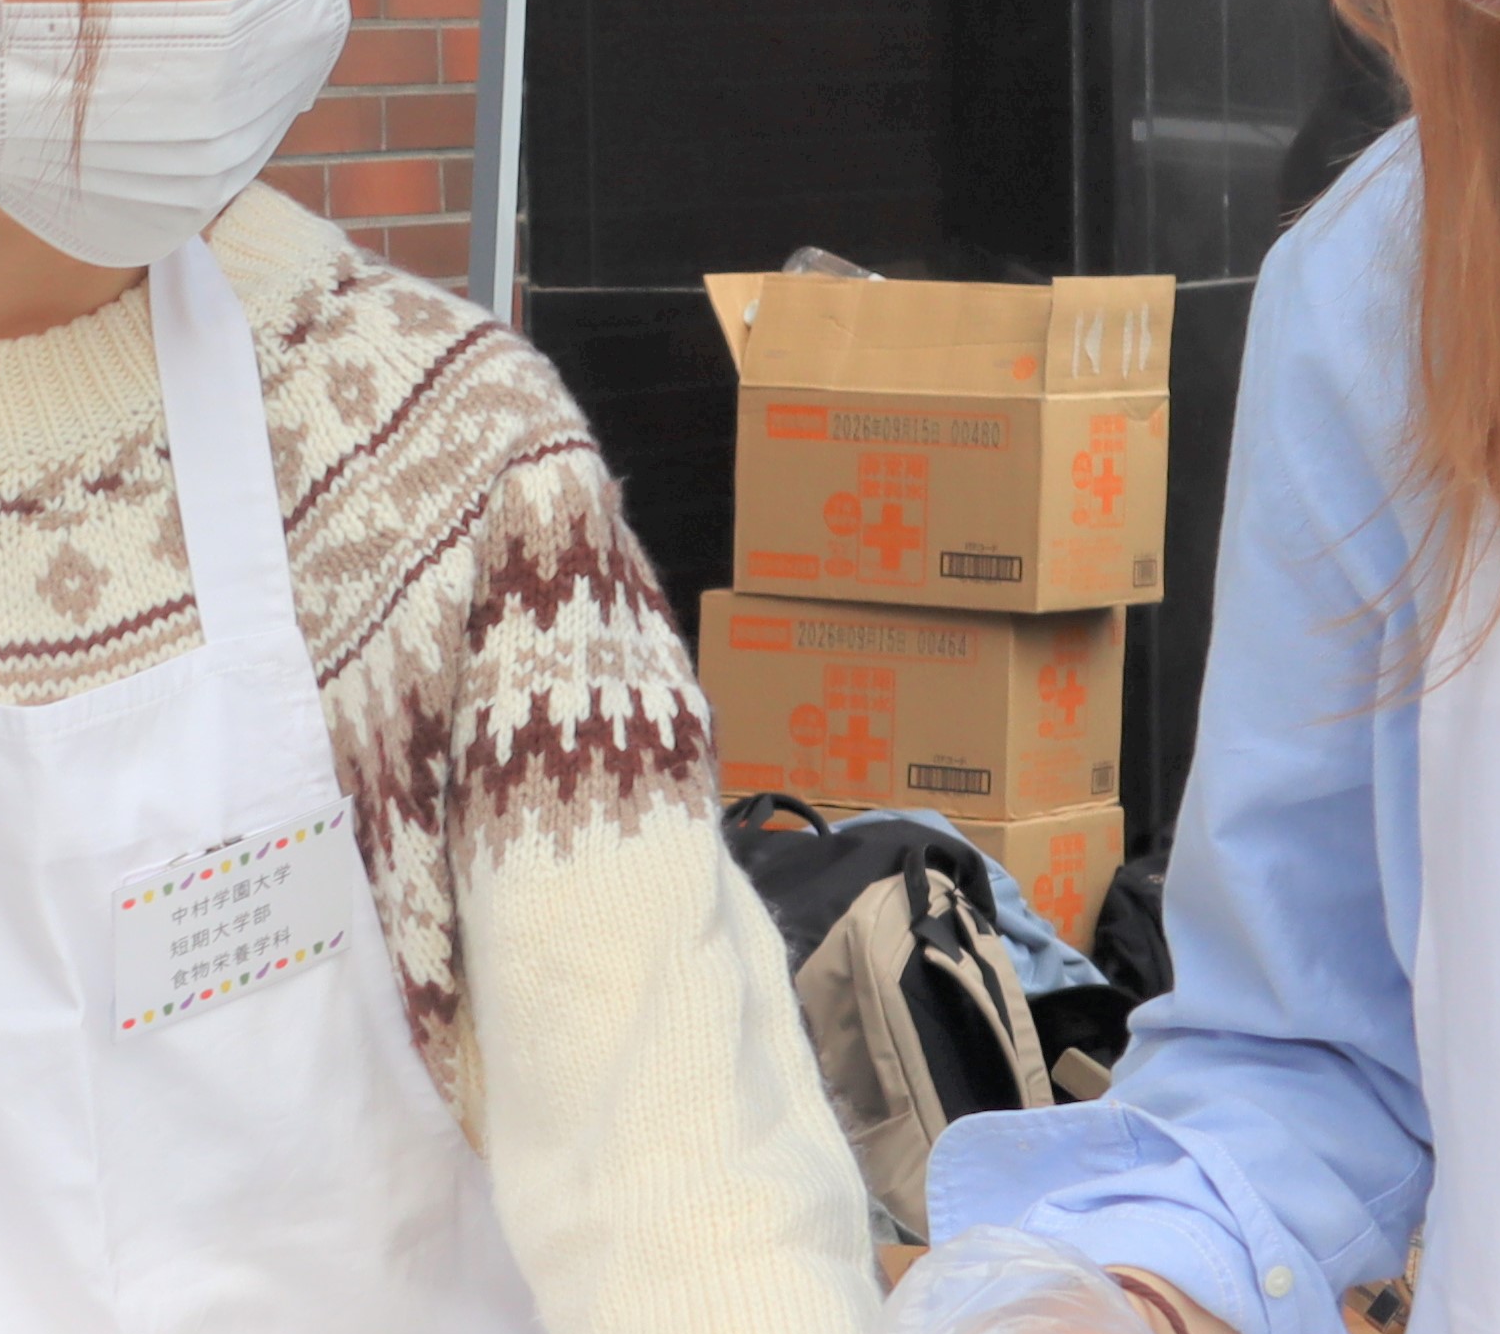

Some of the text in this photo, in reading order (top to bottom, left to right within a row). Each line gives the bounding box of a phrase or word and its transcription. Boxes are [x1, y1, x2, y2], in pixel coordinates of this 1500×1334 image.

[172, 865, 291, 925] 中村学園大学
[170, 904, 271, 959] 短期大学部
[170, 926, 292, 990] 食物栄養学科
